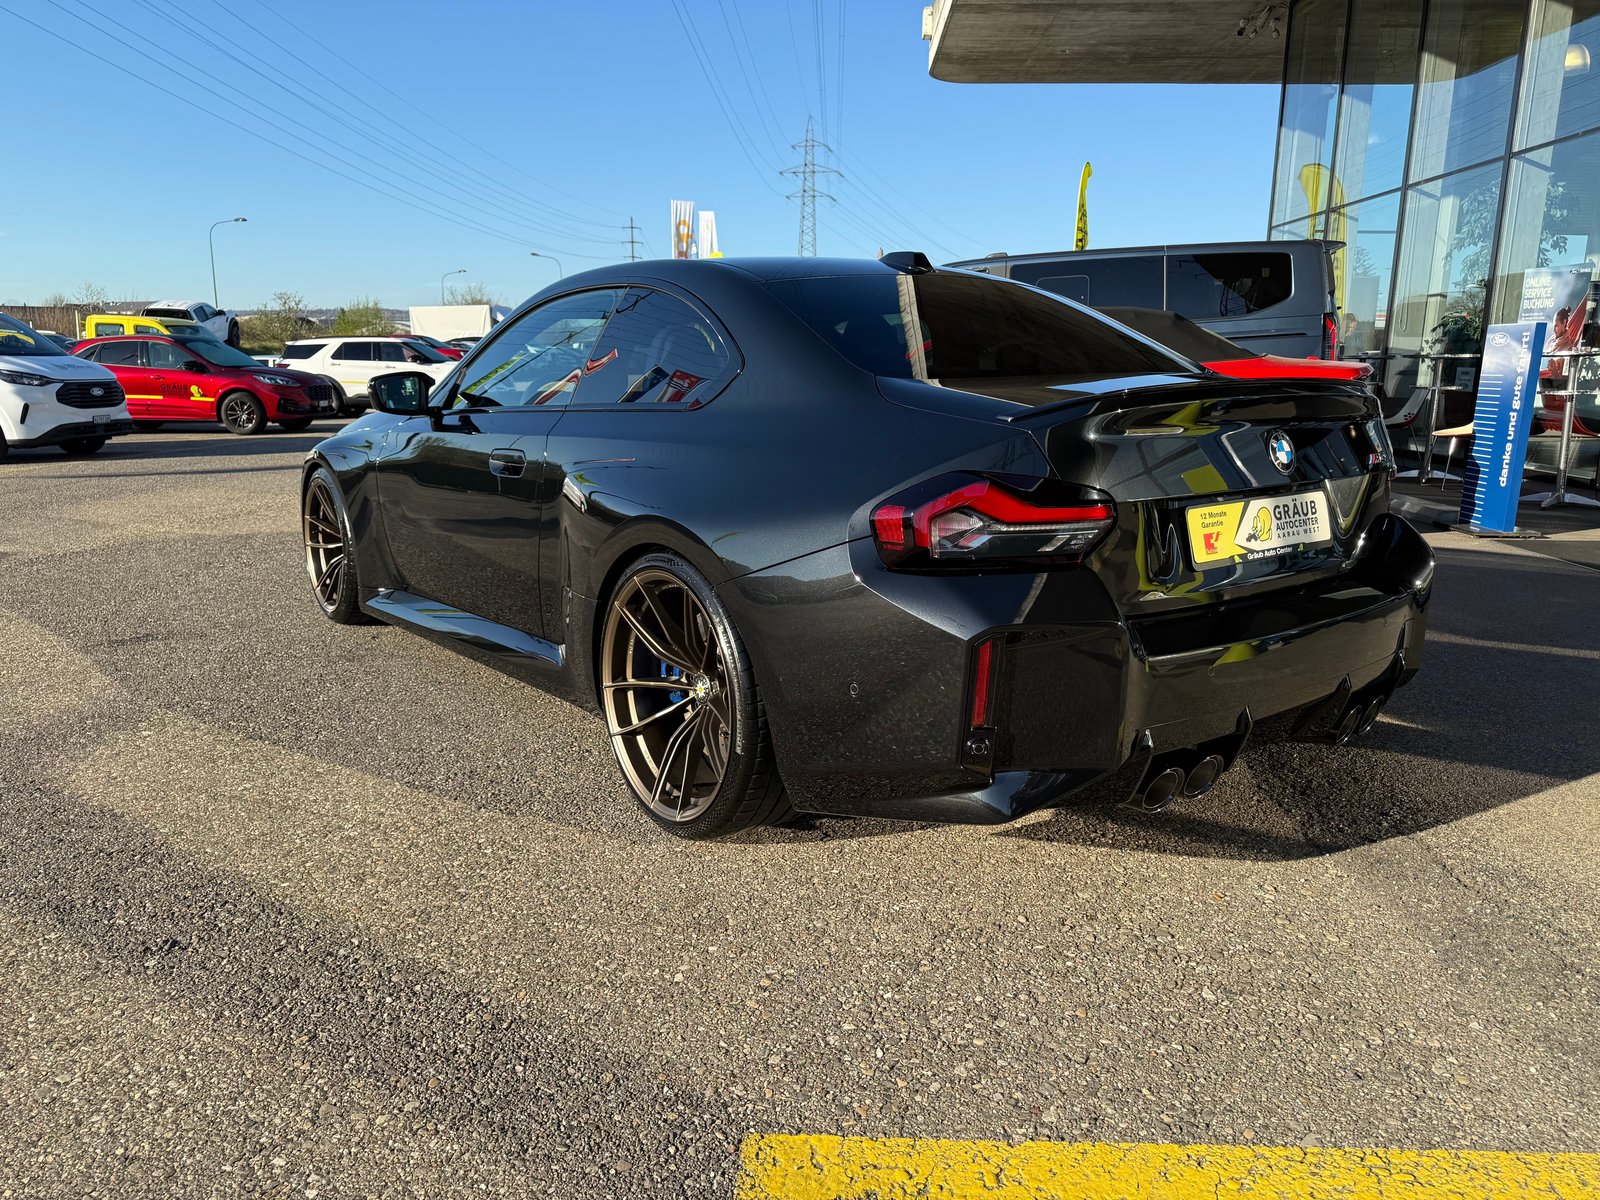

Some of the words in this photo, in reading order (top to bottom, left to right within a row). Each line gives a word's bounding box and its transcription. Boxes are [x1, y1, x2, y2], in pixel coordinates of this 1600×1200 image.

[1525, 276, 1552, 288] ONLINE
[1524, 287, 1553, 299] SERVICE
[1523, 298, 1555, 310] BUCHUNG
[1516, 331, 1531, 374] fahrt!
[1512, 375, 1523, 410] gute
[1507, 412, 1518, 440] und
[1499, 442, 1513, 487] danke
[1200, 512, 1207, 520] 12
[1208, 510, 1227, 519] Monate
[1273, 498, 1317, 521] GRÄUB
[1201, 520, 1224, 529] Garantie
[1276, 516, 1319, 531] AUTOCENTER
[1277, 530, 1300, 539] AARAU
[1303, 526, 1319, 535] WEST
[1247, 551, 1264, 560] Gräub
[1264, 549, 1276, 557] Auto
[1276, 546, 1293, 555] Center
